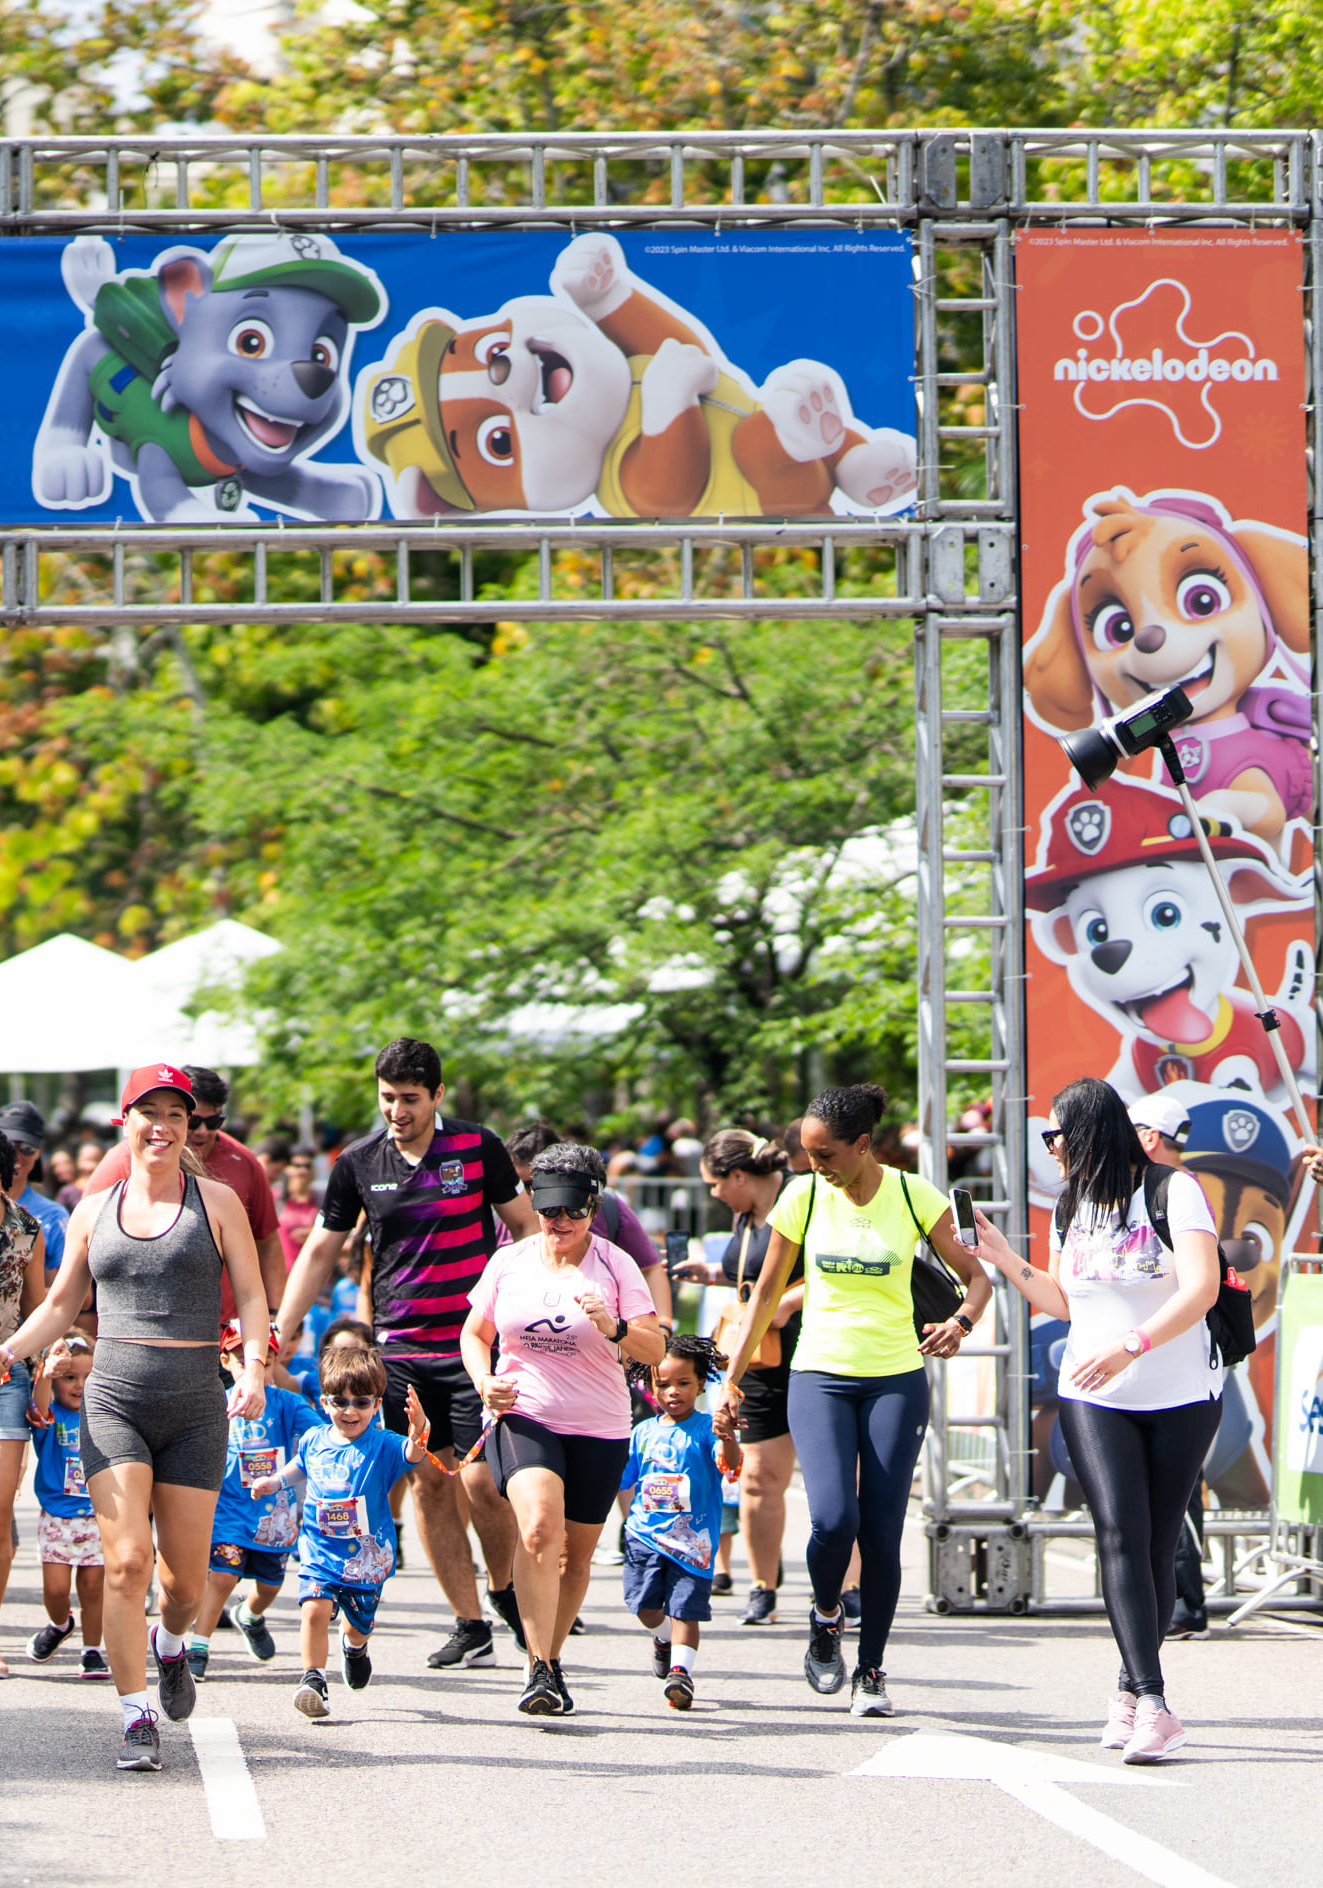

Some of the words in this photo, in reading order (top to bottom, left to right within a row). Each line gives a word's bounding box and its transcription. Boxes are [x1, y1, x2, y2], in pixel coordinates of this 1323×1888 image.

[689, 245, 715, 253] Master
[739, 245, 767, 253] Viacom
[768, 245, 817, 253] International
[832, 244, 843, 252] All
[844, 244, 868, 254] Rights
[1053, 348, 1278, 382] nickelodeon
[248, 1462, 272, 1471] 0558
[649, 1486, 673, 1495] 0655
[325, 1512, 350, 1521] 1468
